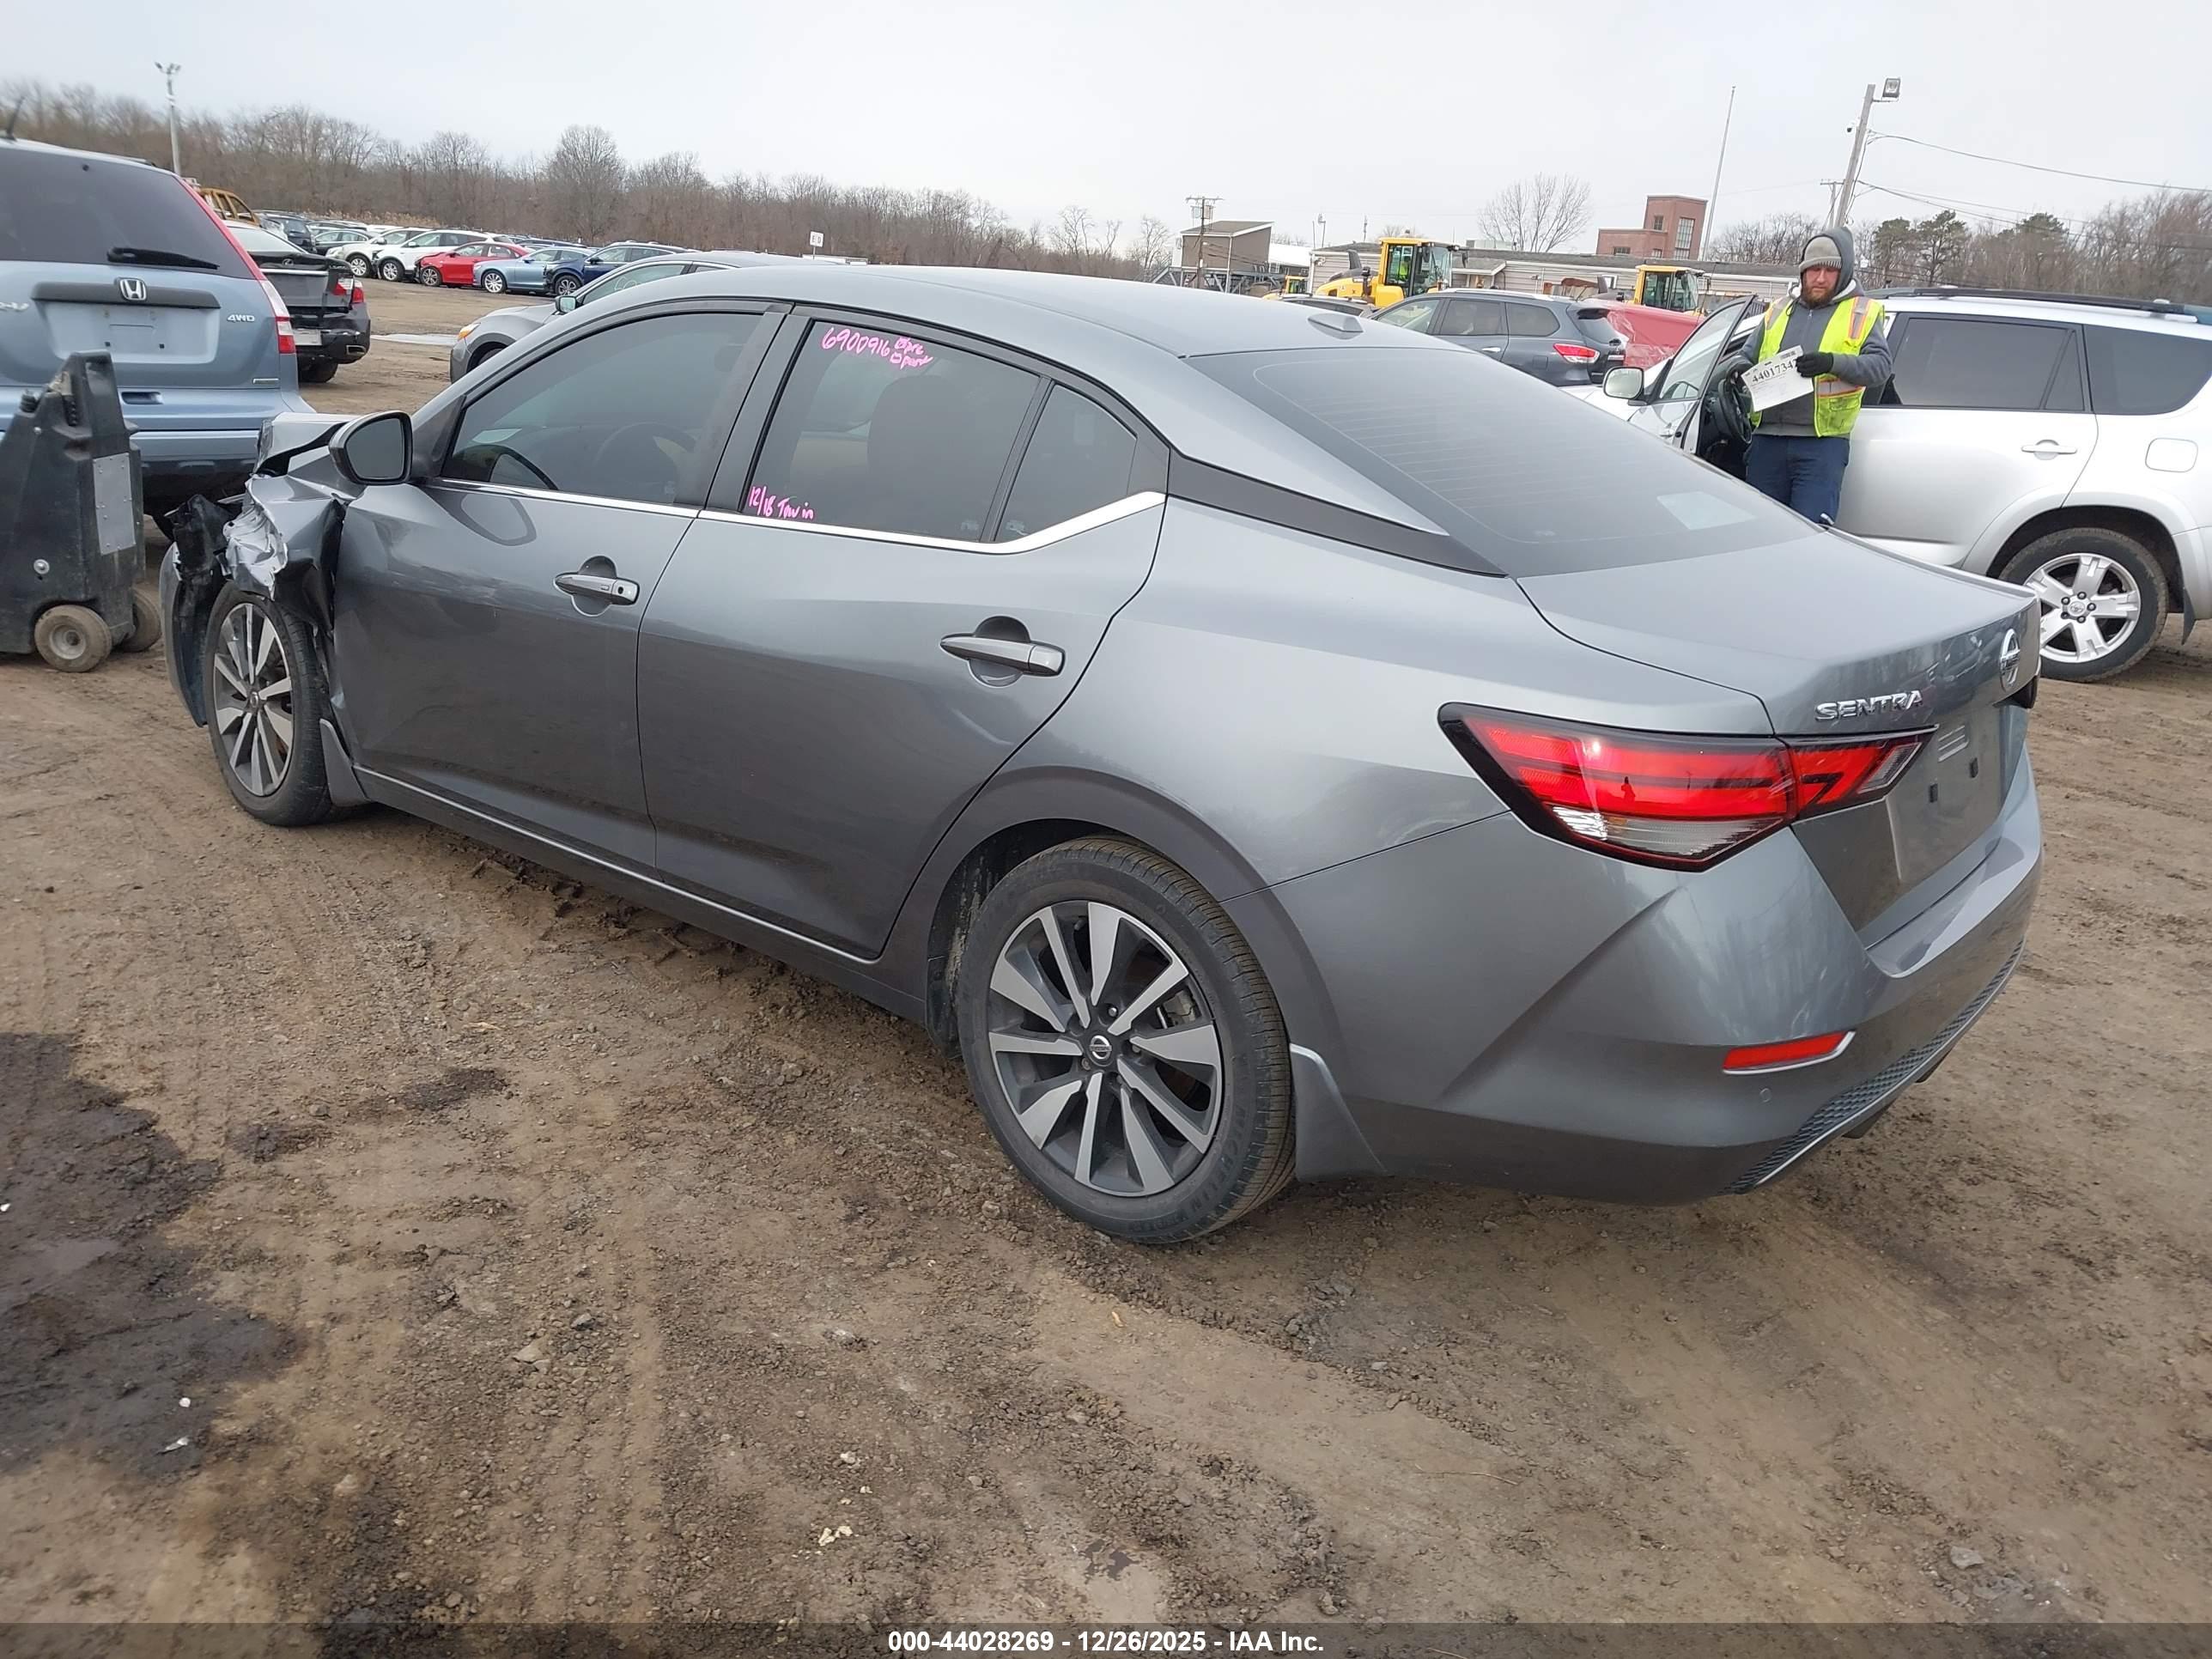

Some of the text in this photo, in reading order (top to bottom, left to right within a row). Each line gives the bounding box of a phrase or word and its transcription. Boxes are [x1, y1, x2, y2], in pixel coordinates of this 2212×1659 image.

[227, 314, 255, 323] 4WD
[822, 326, 891, 357] 6900916
[749, 486, 776, 517] 12/18
[802, 501, 814, 520] in
[1814, 690, 1923, 721] SENTRA
